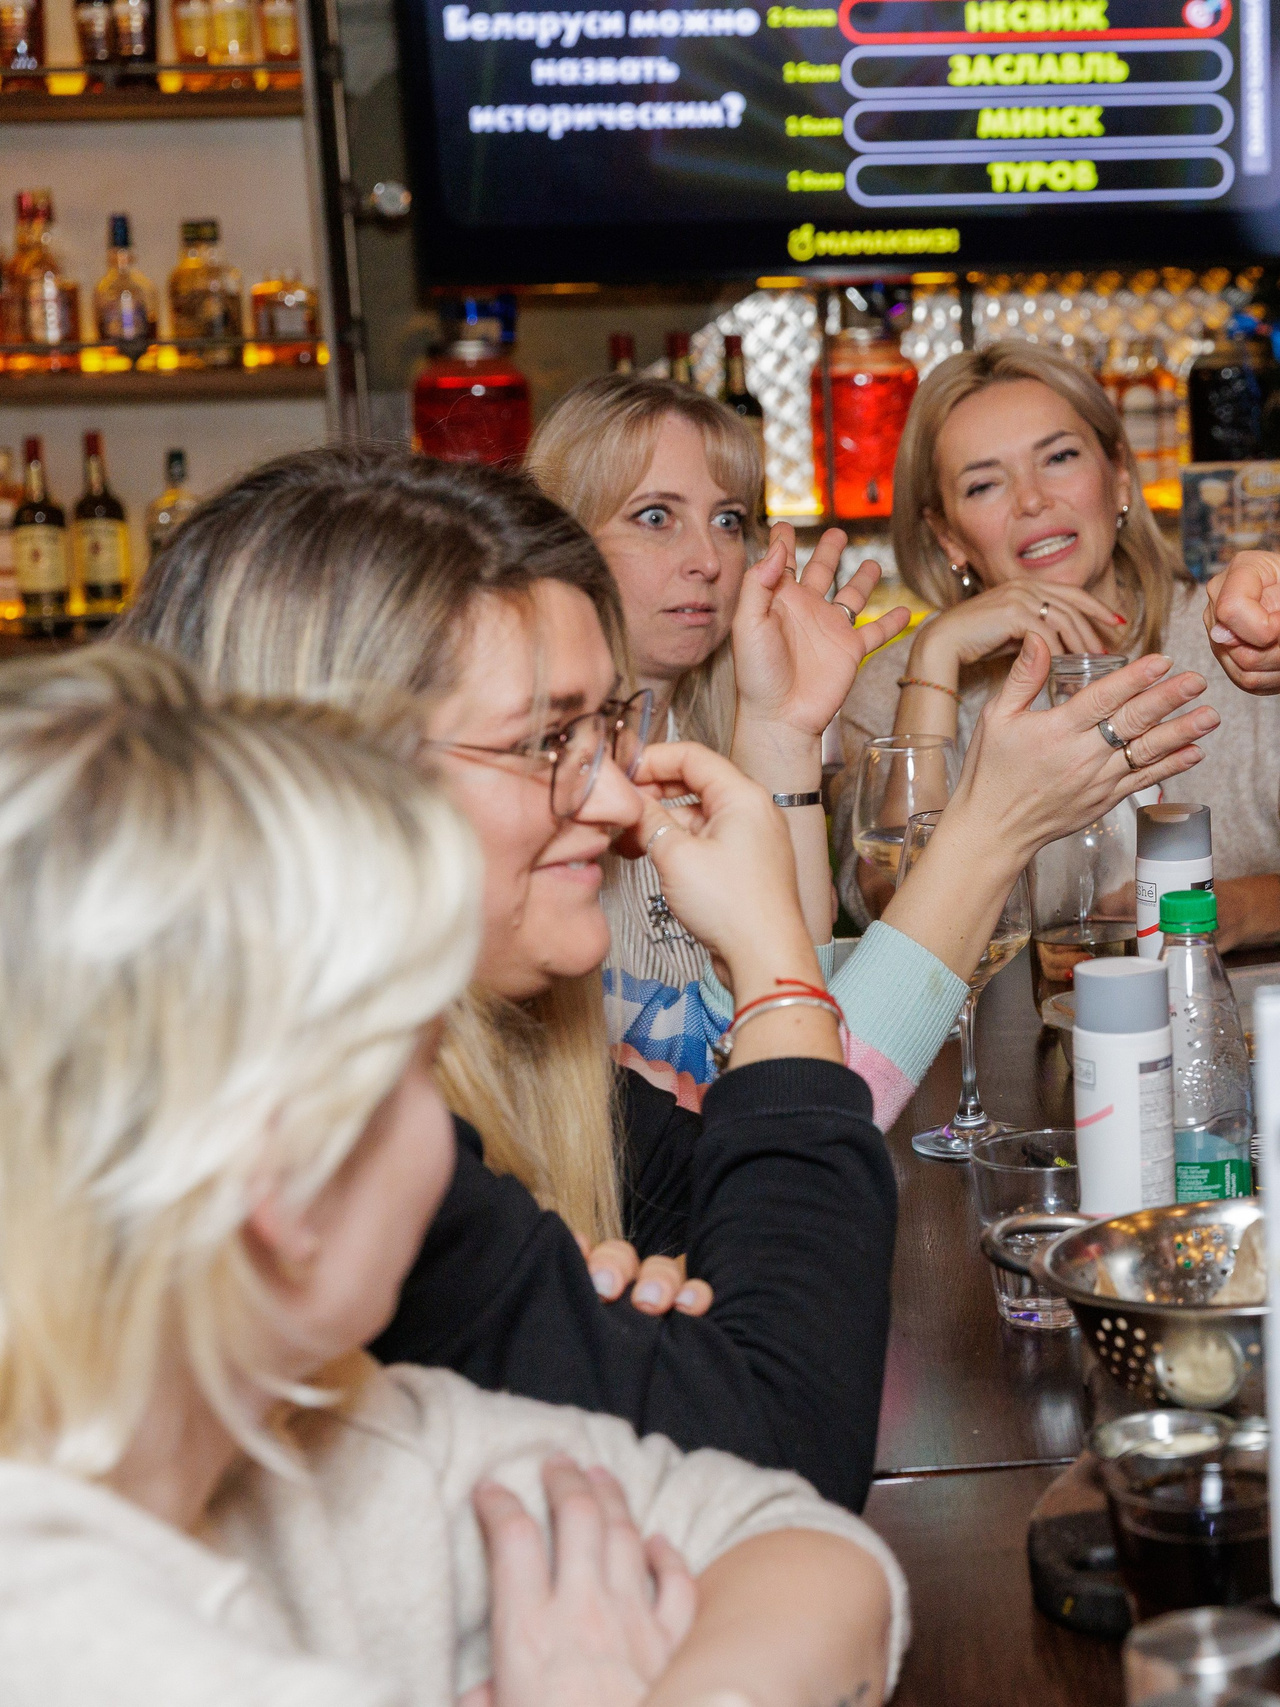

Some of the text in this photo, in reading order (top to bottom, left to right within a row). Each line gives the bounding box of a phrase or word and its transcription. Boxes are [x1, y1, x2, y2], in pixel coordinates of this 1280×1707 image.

[443, 4, 761, 48] Беларуси можно
[964, 0, 1110, 33] НЕСВИЖ
[531, 56, 680, 86] назвать
[947, 51, 1130, 86] ЗАСЛАВЛЬ
[468, 91, 747, 140] историческим?
[976, 105, 1105, 139] МИНСК
[986, 159, 1099, 193] ТУРОВ
